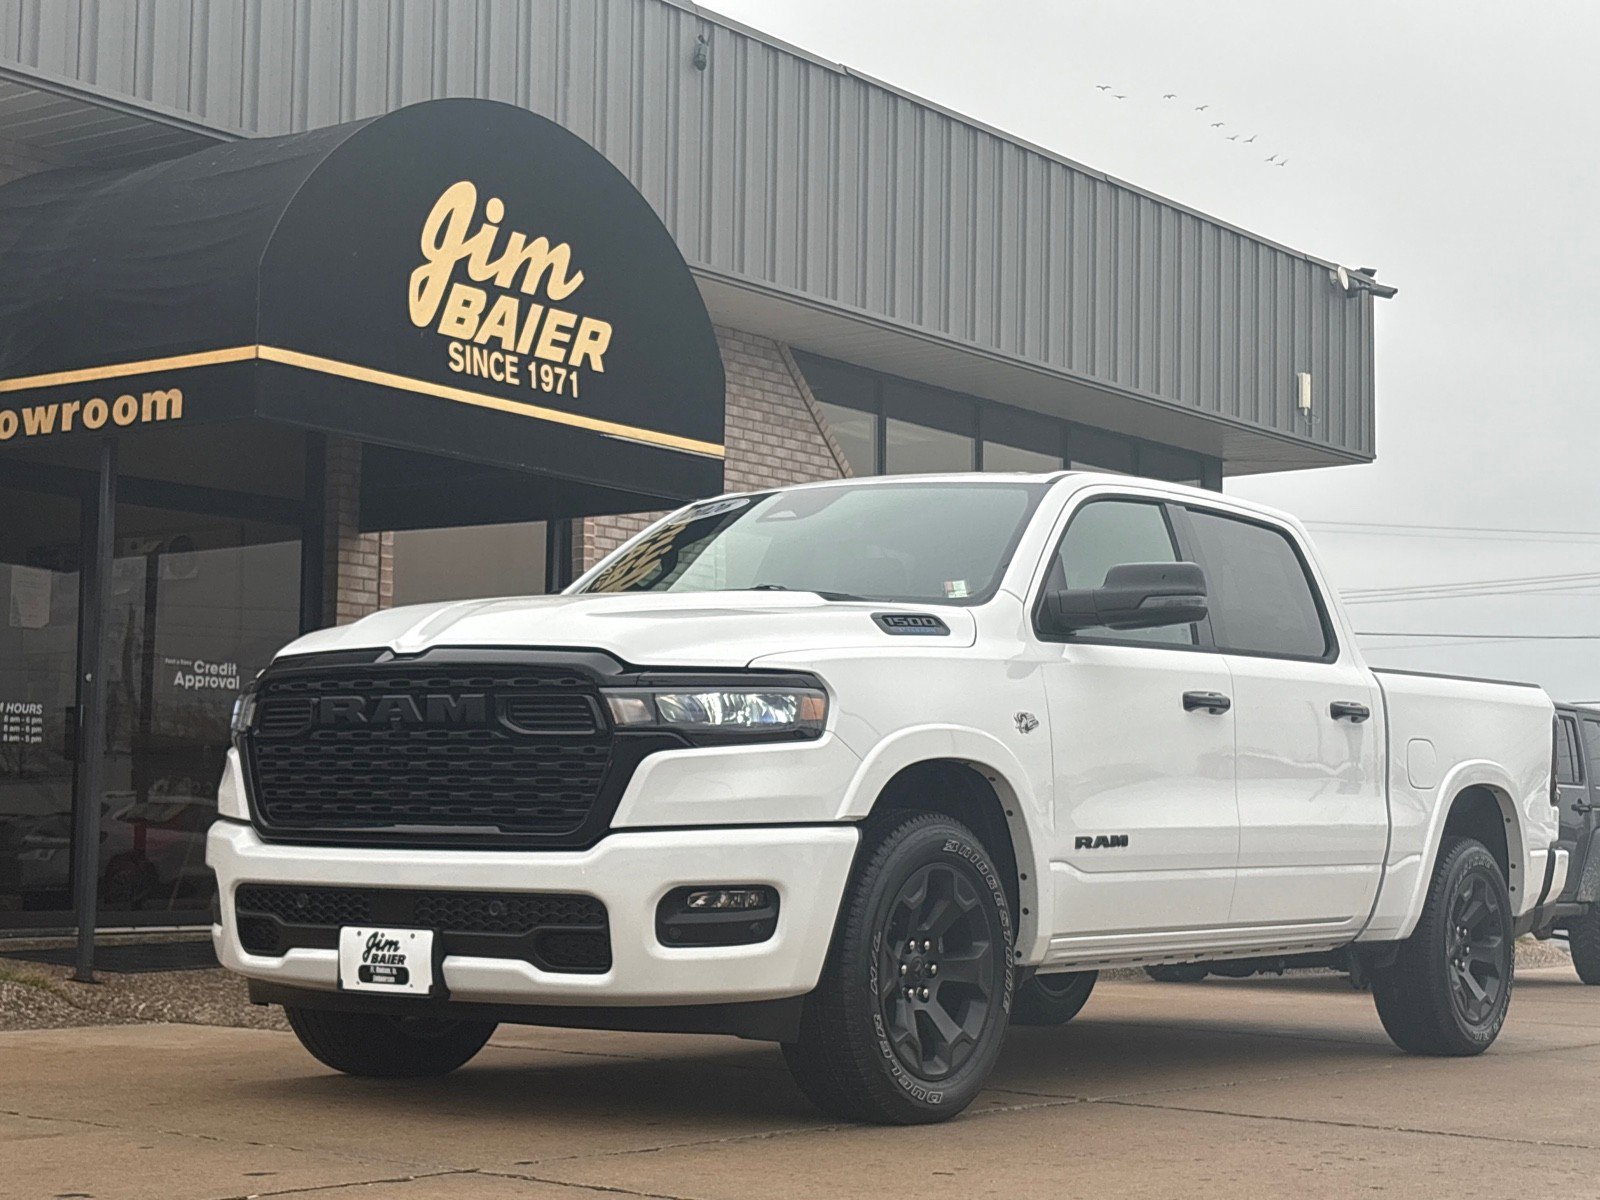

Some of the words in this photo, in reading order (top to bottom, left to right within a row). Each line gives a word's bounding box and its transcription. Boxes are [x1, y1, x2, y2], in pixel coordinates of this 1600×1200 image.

[409, 180, 585, 328] Jim
[437, 282, 613, 373] BAIER
[448, 341, 521, 386] SINCE
[527, 361, 579, 398] 1971
[0, 388, 183, 440] owroom
[884, 616, 938, 627] 1500
[173, 670, 240, 690] Approval
[194, 660, 237, 676] Credit
[6, 702, 43, 715] HOURS
[319, 694, 486, 722] RAM
[1074, 834, 1129, 850] RAM
[362, 931, 400, 963] Jim
[370, 953, 407, 965] BAIER
